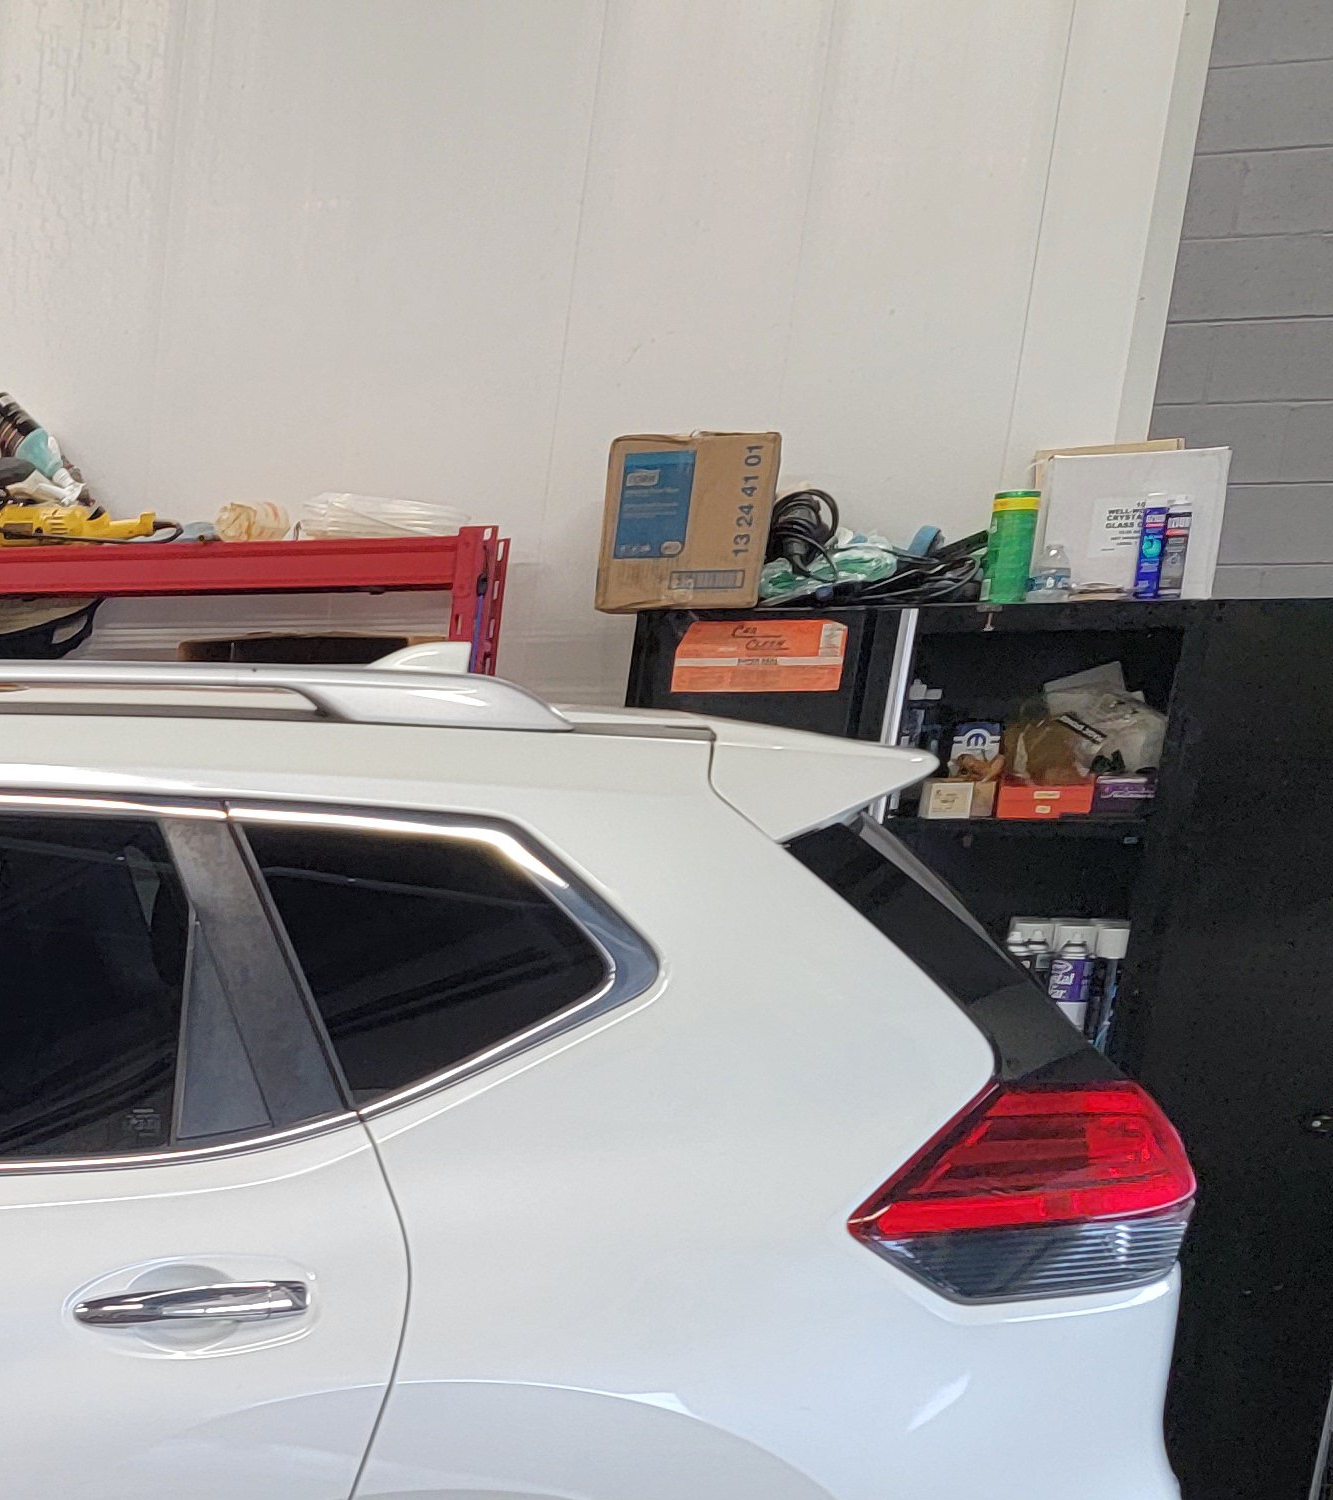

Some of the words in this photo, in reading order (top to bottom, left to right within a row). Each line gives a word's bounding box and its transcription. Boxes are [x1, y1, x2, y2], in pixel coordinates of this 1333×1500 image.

[745, 444, 764, 467] 01
[741, 475, 759, 497] 41
[736, 504, 754, 528] 24
[732, 533, 751, 557] 13
